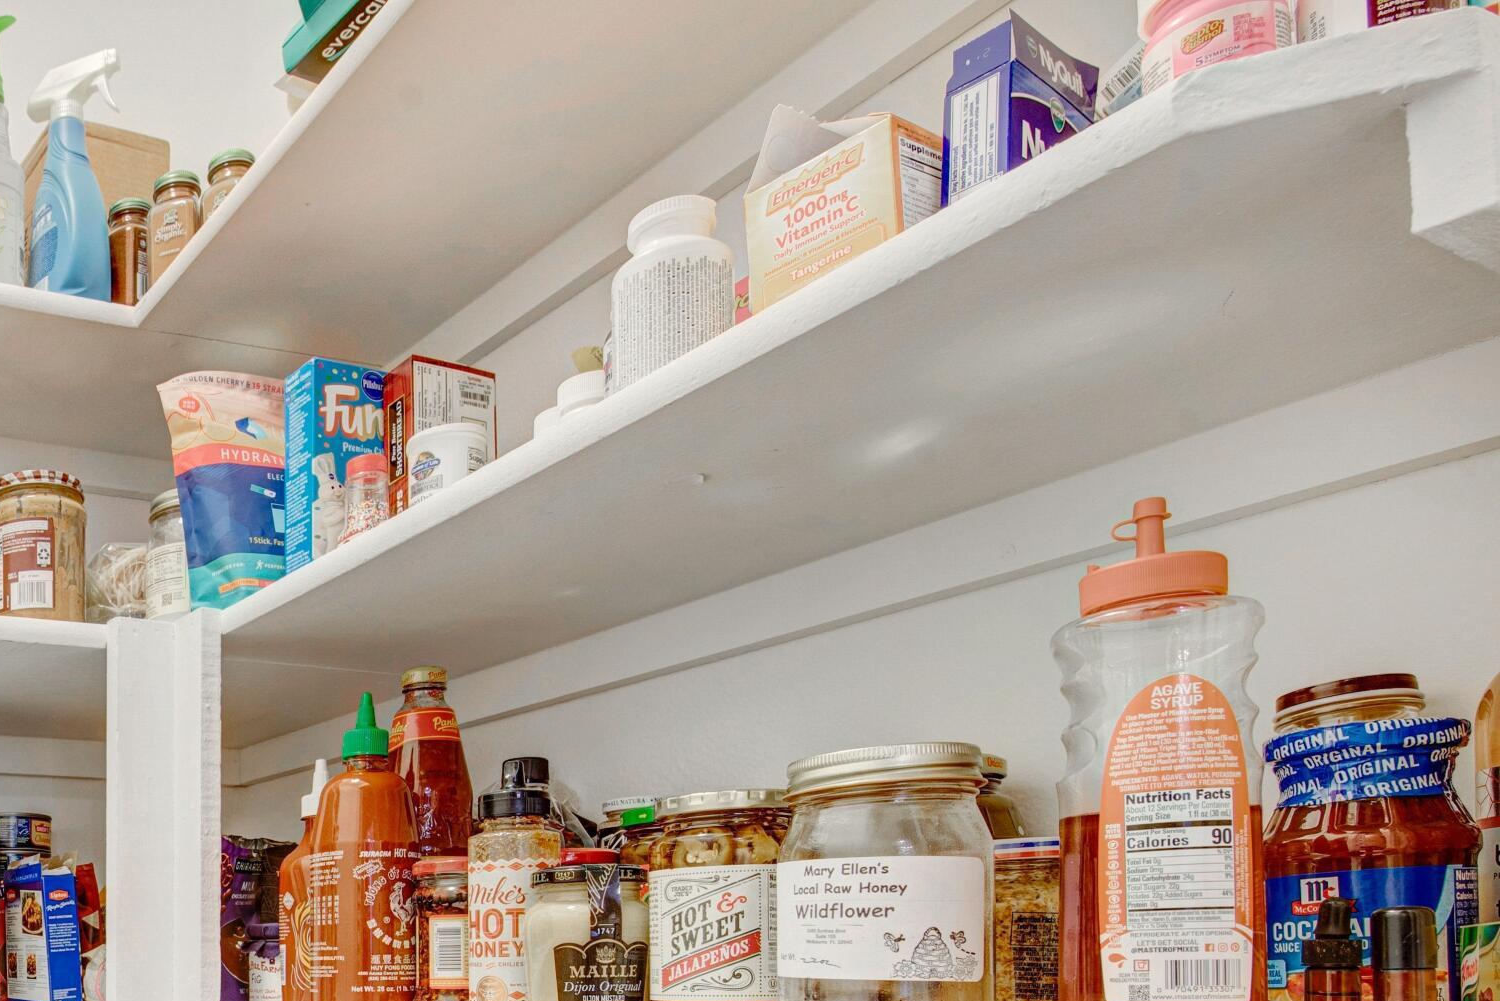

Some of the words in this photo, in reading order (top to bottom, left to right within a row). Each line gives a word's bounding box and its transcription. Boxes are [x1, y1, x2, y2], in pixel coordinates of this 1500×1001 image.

[1039, 44, 1084, 98] NyQuil
[771, 148, 858, 207] Emergen-C
[830, 189, 849, 206] mg
[776, 207, 843, 248] Vitamin
[846, 195, 859, 212] C
[790, 246, 852, 281] Tangerine
[1151, 681, 1203, 698] AGAVE
[1150, 694, 1204, 710] SYRUP
[1273, 728, 1350, 761] ORIGINAL
[1403, 723, 1470, 748] ORIGINAL
[1303, 743, 1388, 770] ORIGINAL
[1334, 754, 1420, 785] ORIGINAL
[1126, 790, 1191, 805] Nutrition
[1196, 788, 1231, 800] Facts
[1364, 773, 1442, 797] ORIGINAL
[1127, 834, 1189, 849] Calories
[1212, 828, 1232, 844] 90
[359, 850, 392, 858] SRIRACHA
[394, 848, 407, 858] HOT
[803, 864, 835, 879] Mary
[841, 862, 889, 876] Ellen's
[470, 877, 526, 905] Mike's
[793, 883, 819, 895] Local
[825, 882, 852, 894] Raw
[859, 881, 908, 896] Honey
[671, 899, 711, 935] HOT
[716, 891, 747, 913] &
[795, 902, 896, 919] Wildflower
[469, 907, 525, 940] HOT
[670, 910, 745, 958] SWEET
[469, 941, 524, 958] HONEY
[668, 939, 750, 981] JALAPEÑOS
[569, 964, 638, 979] MAILLE
[563, 980, 598, 995] Dijon
[599, 979, 642, 994] Original
